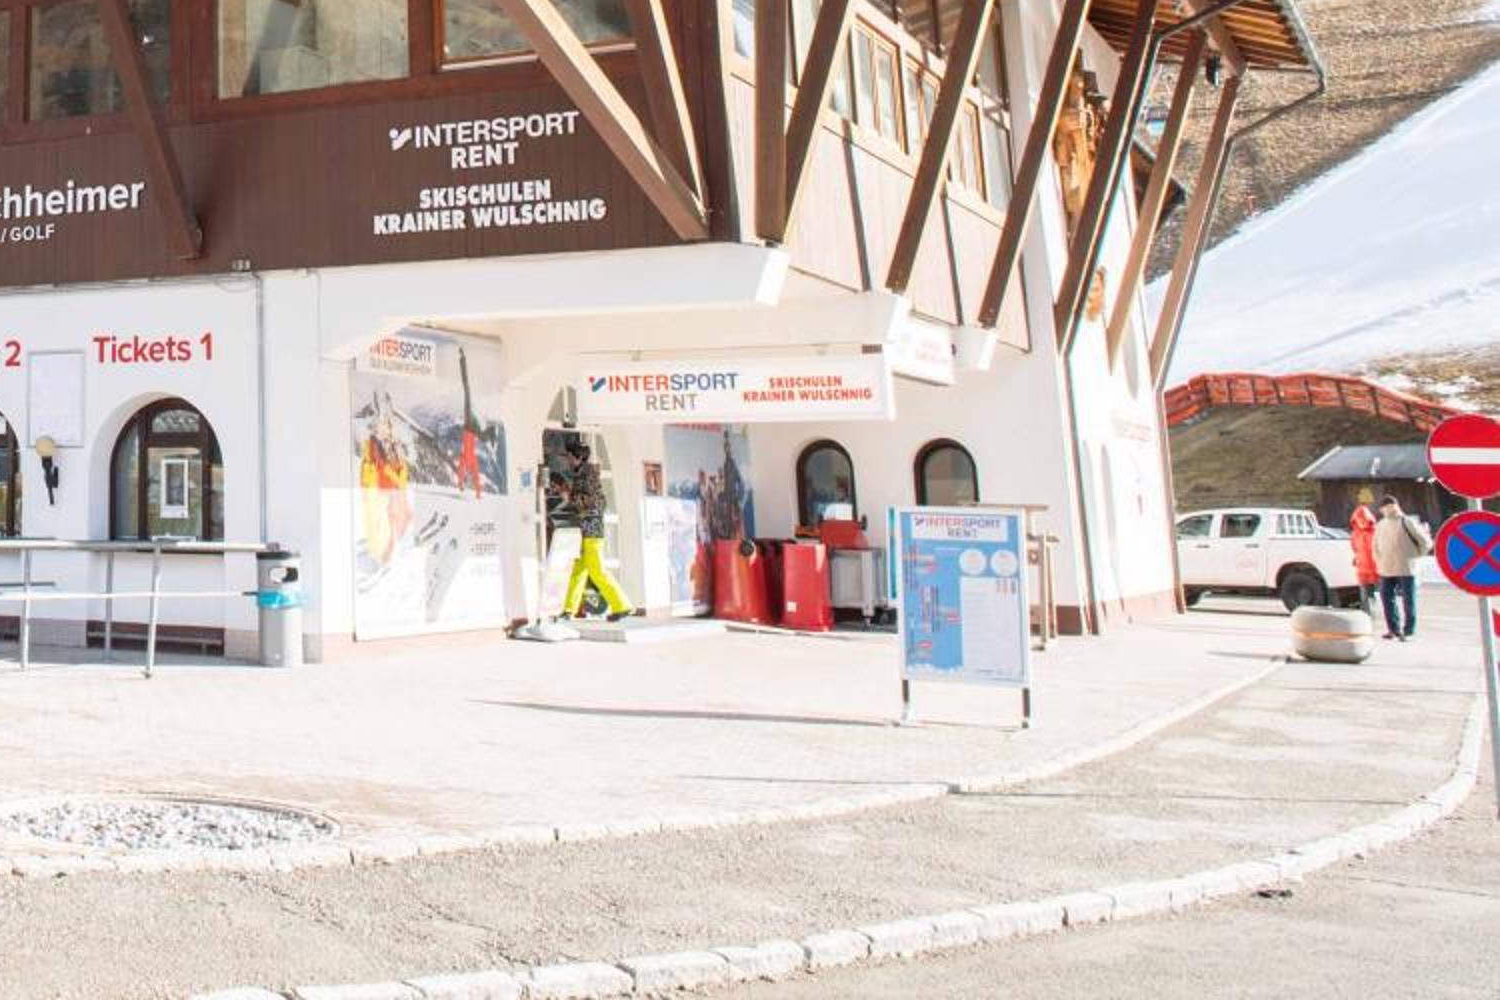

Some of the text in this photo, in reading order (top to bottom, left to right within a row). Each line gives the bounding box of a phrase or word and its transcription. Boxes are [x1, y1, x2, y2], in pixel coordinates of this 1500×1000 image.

[415, 111, 580, 148] INTERSPORT
[451, 142, 519, 169] RENT
[419, 179, 551, 209] SKISCHULEN
[373, 198, 607, 235] KRAINER WULSCHNIG
[10, 224, 56, 242] GOLF
[5, 340, 21, 367] 2
[93, 332, 213, 363] Tickets 1
[609, 373, 738, 392] INTERSPORT
[743, 388, 873, 402] KRAINER WULSCHNIG
[769, 375, 842, 388] SKISCHULEN
[645, 393, 698, 411] RENT
